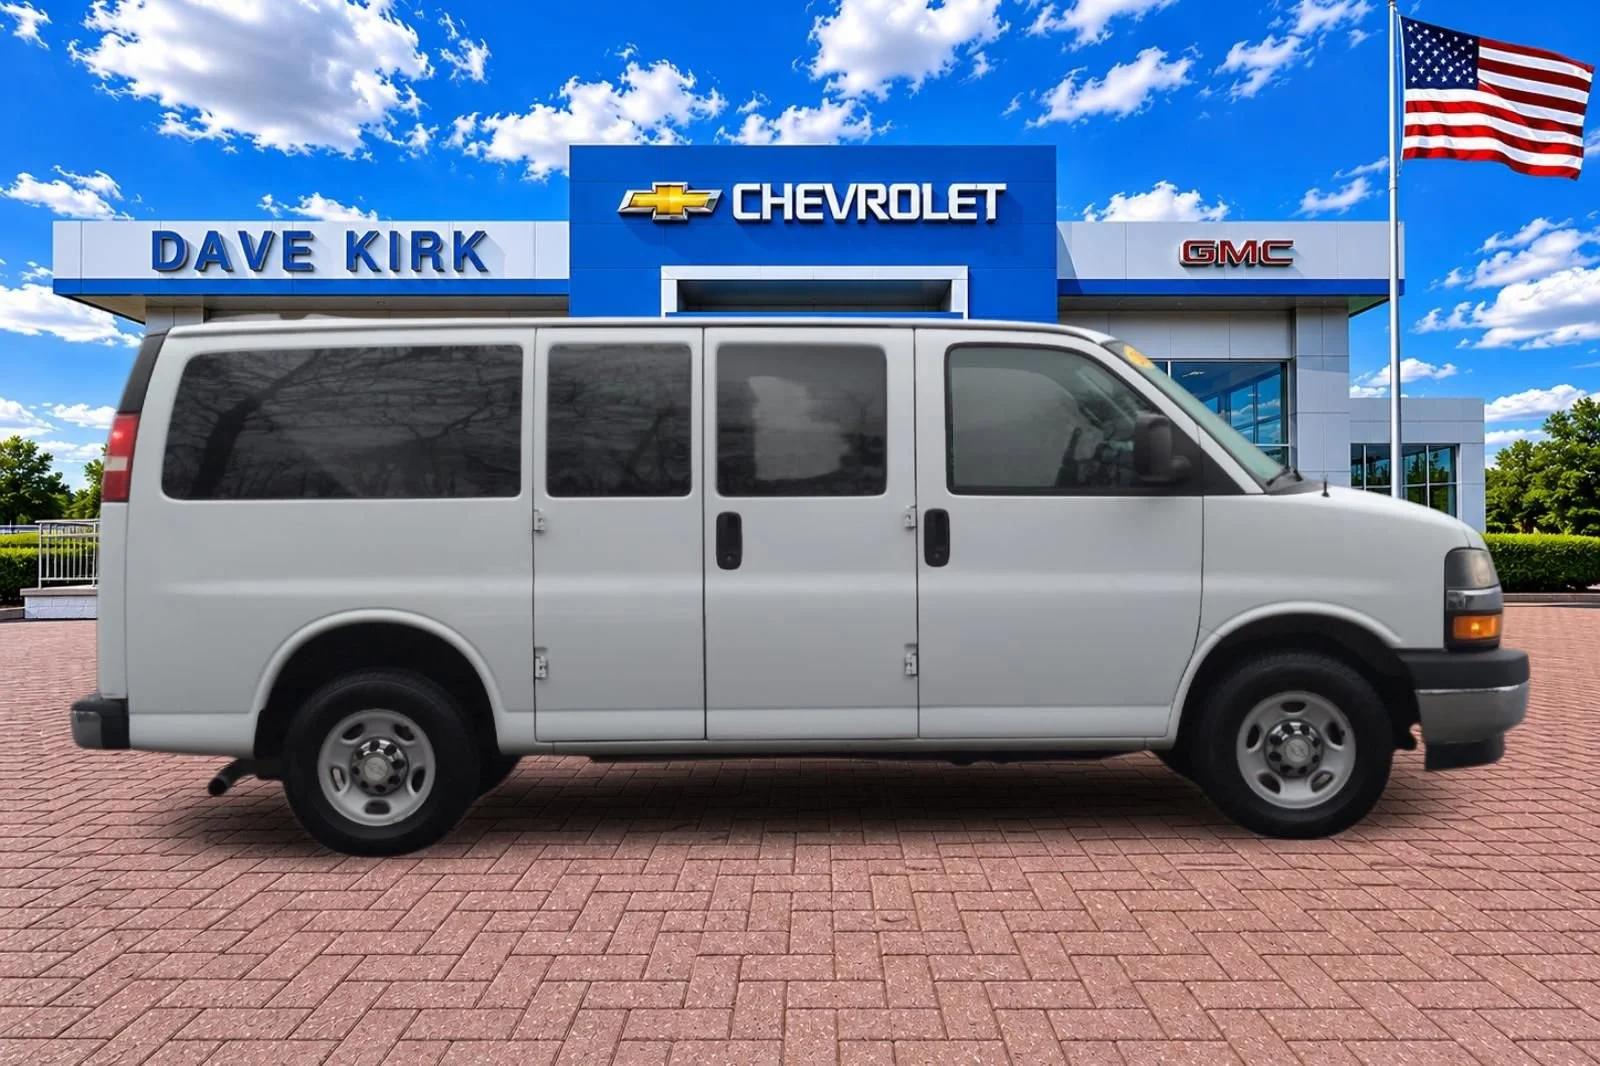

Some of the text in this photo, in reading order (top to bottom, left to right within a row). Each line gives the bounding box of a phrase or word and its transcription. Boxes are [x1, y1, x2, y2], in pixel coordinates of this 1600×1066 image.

[732, 182, 1007, 222] CHEVROLET
[151, 229, 489, 273] DAVE KIRK
[1179, 239, 1295, 267] GMC
